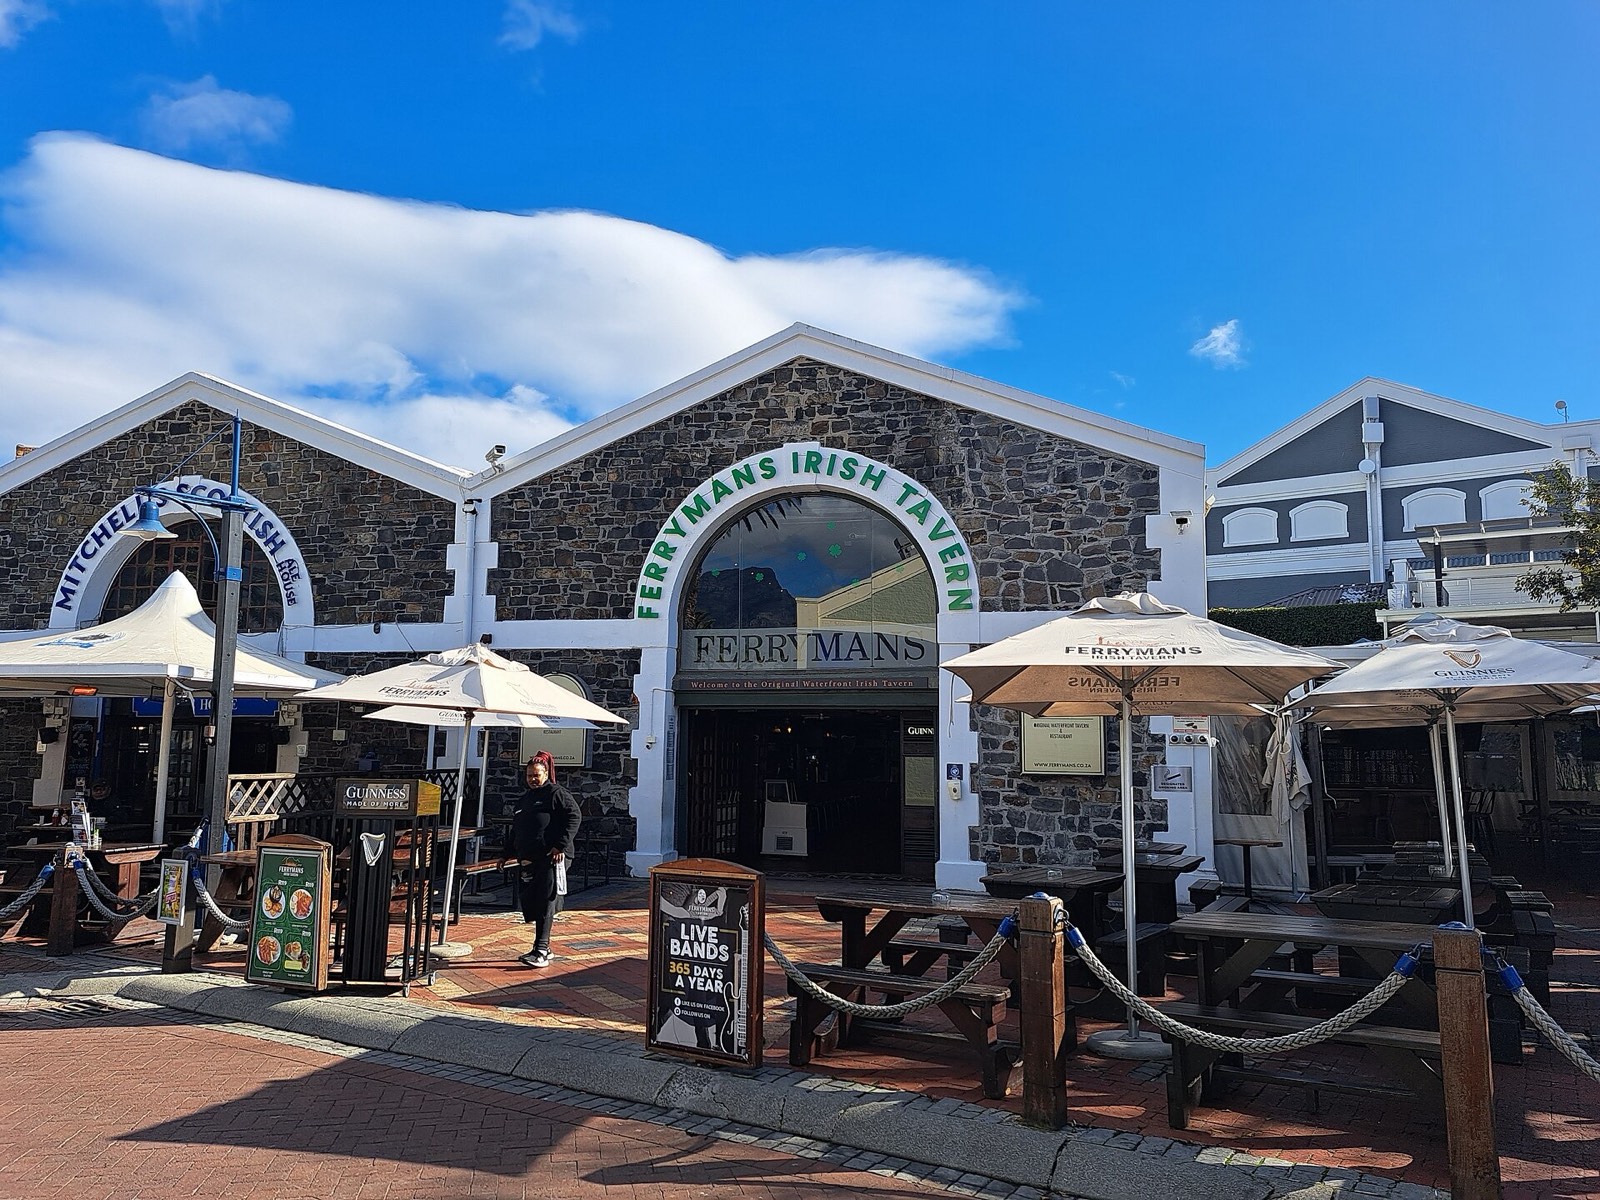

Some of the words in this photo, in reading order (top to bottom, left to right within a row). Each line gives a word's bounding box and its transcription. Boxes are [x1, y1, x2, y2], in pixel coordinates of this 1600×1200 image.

[176, 483, 287, 556] SCOISH
[638, 457, 777, 619] FERRYMANS
[792, 451, 887, 492] IRISH
[896, 482, 973, 611] TAVERN
[285, 559, 302, 582] ALE
[276, 561, 297, 606] HOUSE
[693, 631, 925, 663] FERRYMANS
[1065, 646, 1203, 656] FERRYMANS
[1434, 667, 1516, 677] GUINNESS
[379, 686, 450, 697] FERRYMANS
[761, 680, 799, 689] Original
[346, 785, 406, 799] GUINNESS
[278, 865, 304, 874] FERRYMANS
[680, 923, 719, 944] LIVE
[670, 938, 730, 962] BANDS
[669, 961, 691, 975] 365
[693, 965, 724, 980] DAYS
[675, 974, 684, 988] A
[688, 975, 724, 994] YEAR
[703, 1003, 725, 1012] FACEBOOK
